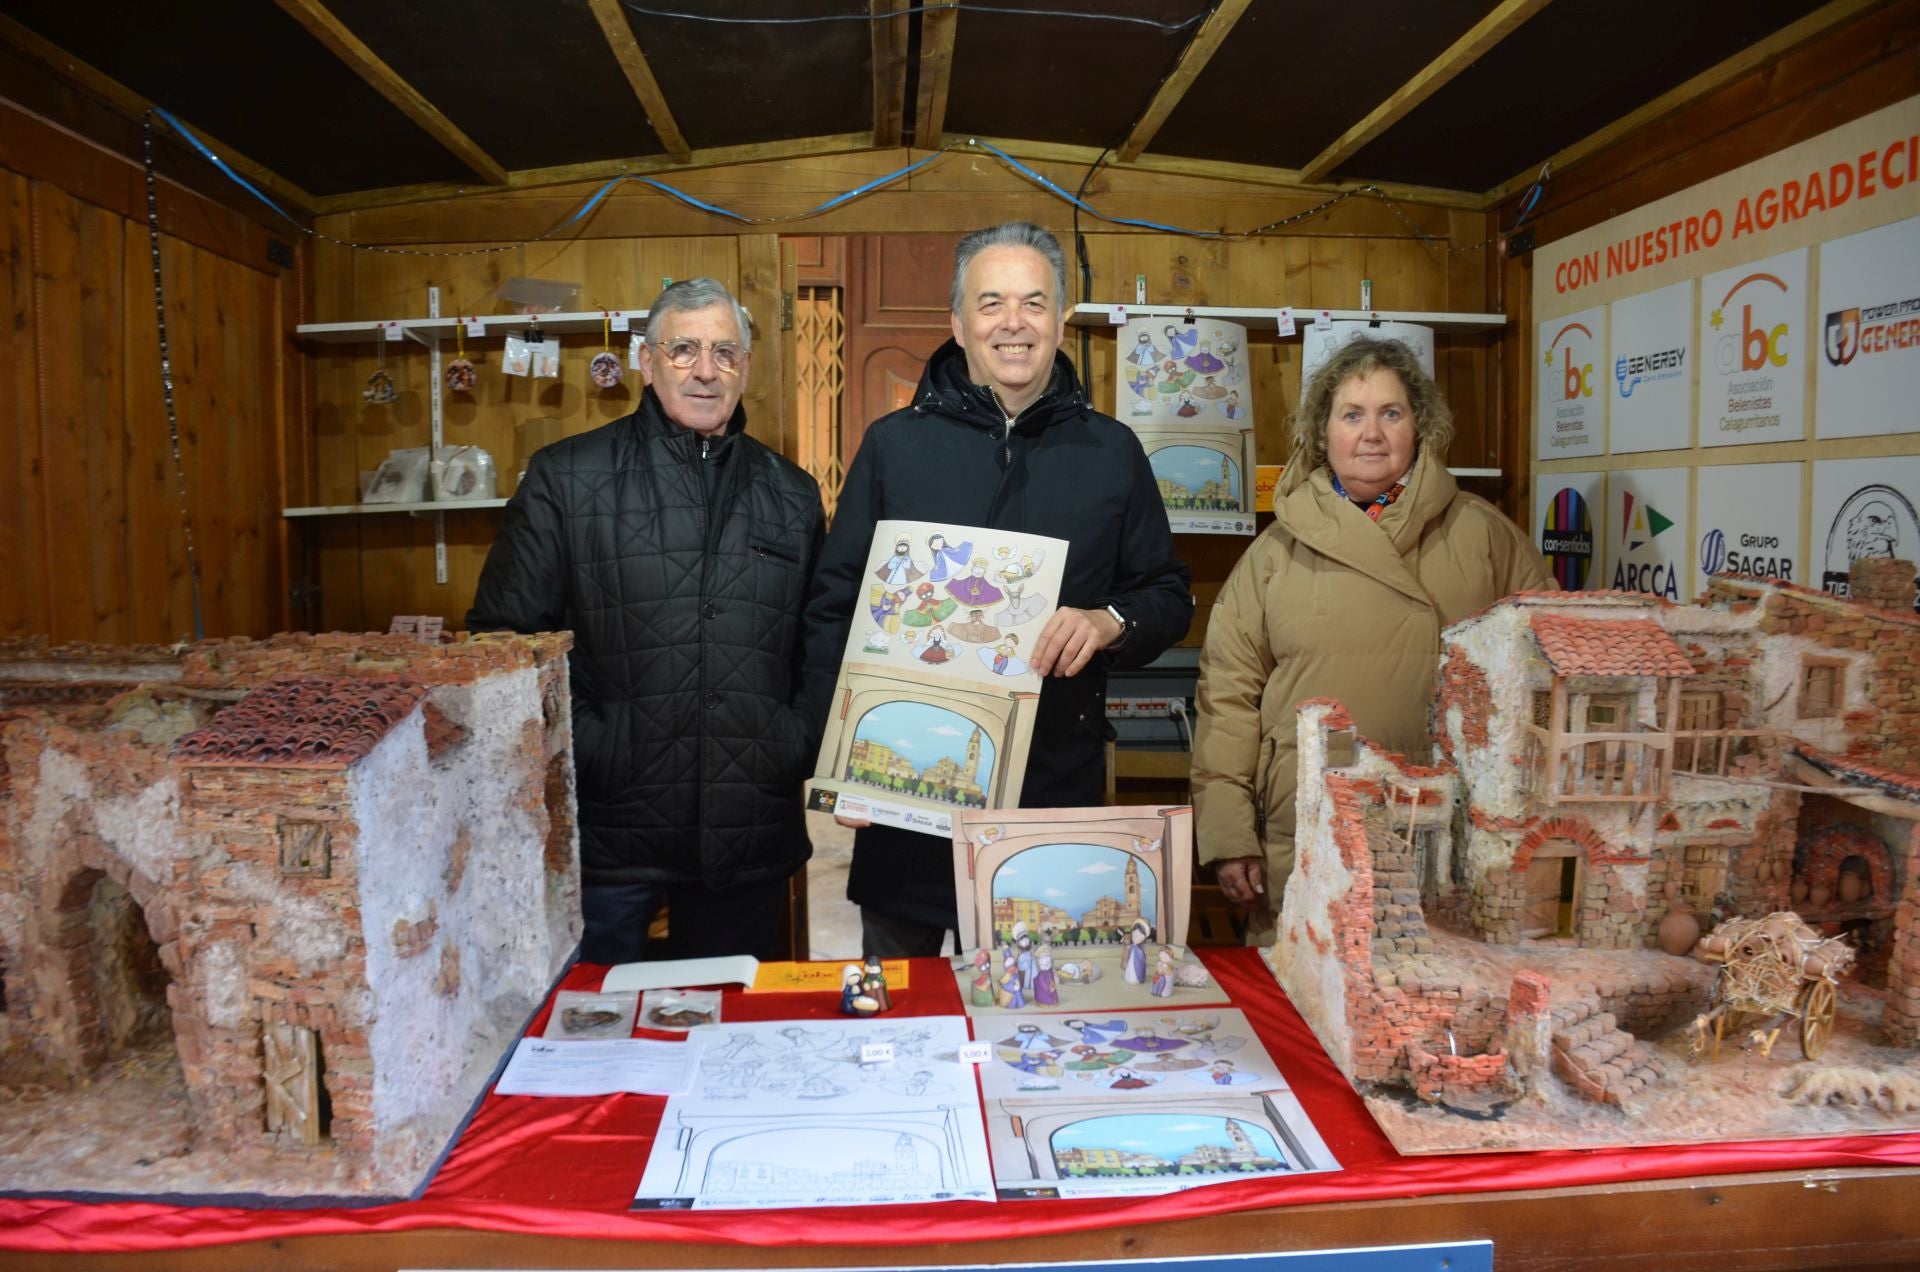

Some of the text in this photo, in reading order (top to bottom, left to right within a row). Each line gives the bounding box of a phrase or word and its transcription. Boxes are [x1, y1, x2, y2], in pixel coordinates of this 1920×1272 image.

[1555, 134, 1920, 294] CON NUESTRO AGRADECI
[1628, 347, 1685, 375] GENERGY
[1727, 376, 1774, 395] Asociación
[1728, 396, 1772, 413] Belenistas
[1740, 533, 1779, 549] GRUPO
[1612, 556, 1678, 600] ARCCA
[1726, 551, 1793, 580] SAGAR
